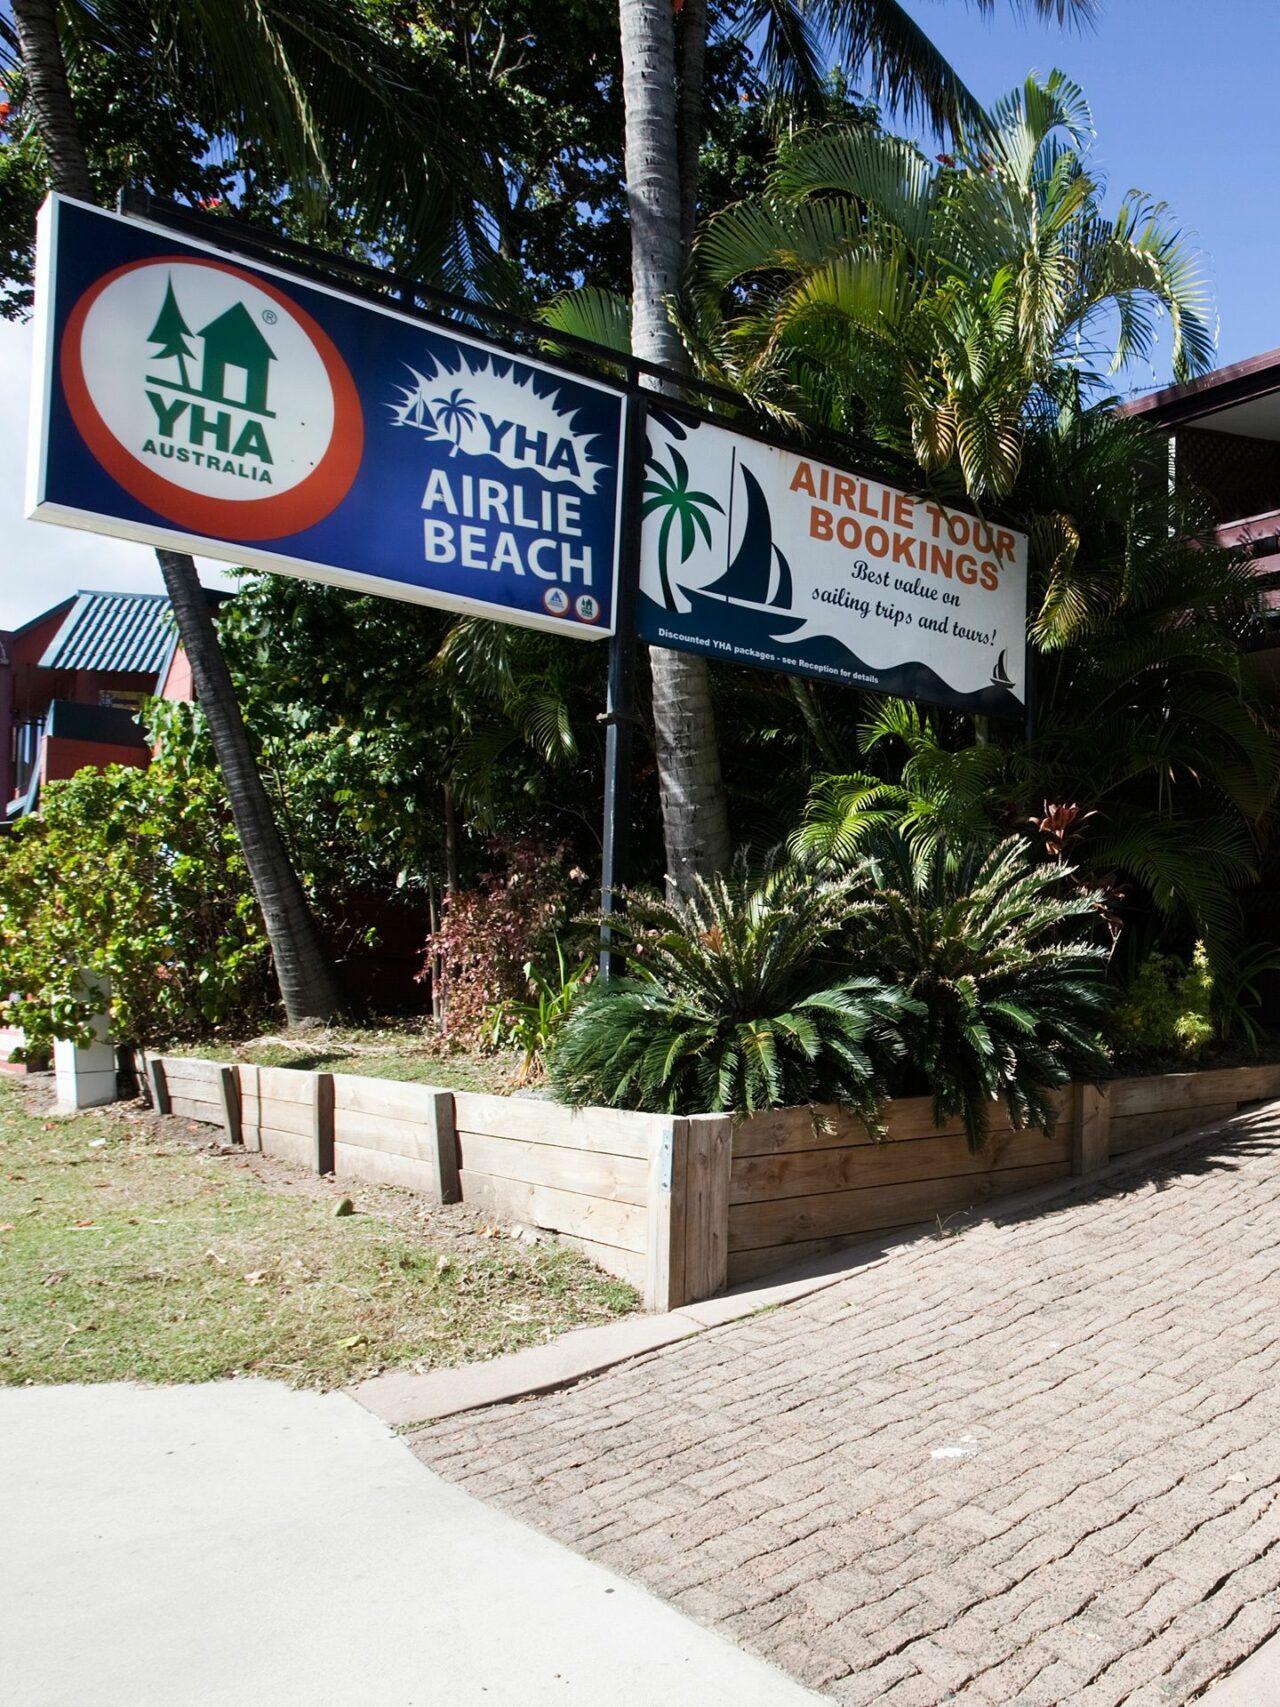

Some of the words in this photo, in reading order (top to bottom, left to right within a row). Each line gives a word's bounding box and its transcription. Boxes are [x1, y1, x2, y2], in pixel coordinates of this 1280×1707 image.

[145, 390, 274, 465] YHA
[479, 412, 582, 477] YHA
[142, 439, 273, 484] AUSTRALIA
[421, 469, 583, 537] AIRLIE
[789, 461, 914, 529] AIRLIE
[926, 504, 1016, 563] TOUR
[423, 519, 593, 586] BEACH
[810, 506, 999, 591] BOOKINGS
[851, 560, 891, 587] Best
[894, 576, 938, 600] value
[942, 591, 961, 606] on
[811, 587, 871, 618] sailing
[876, 600, 912, 627] trips
[918, 616, 949, 634] and
[953, 625, 997, 646] tours!
[658, 628, 710, 647] Discounted
[713, 639, 732, 651] YHA
[734, 645, 775, 662] packages
[782, 656, 797, 666] see
[799, 659, 839, 676] Reception
[840, 667, 851, 678] for
[852, 671, 879, 684] details
